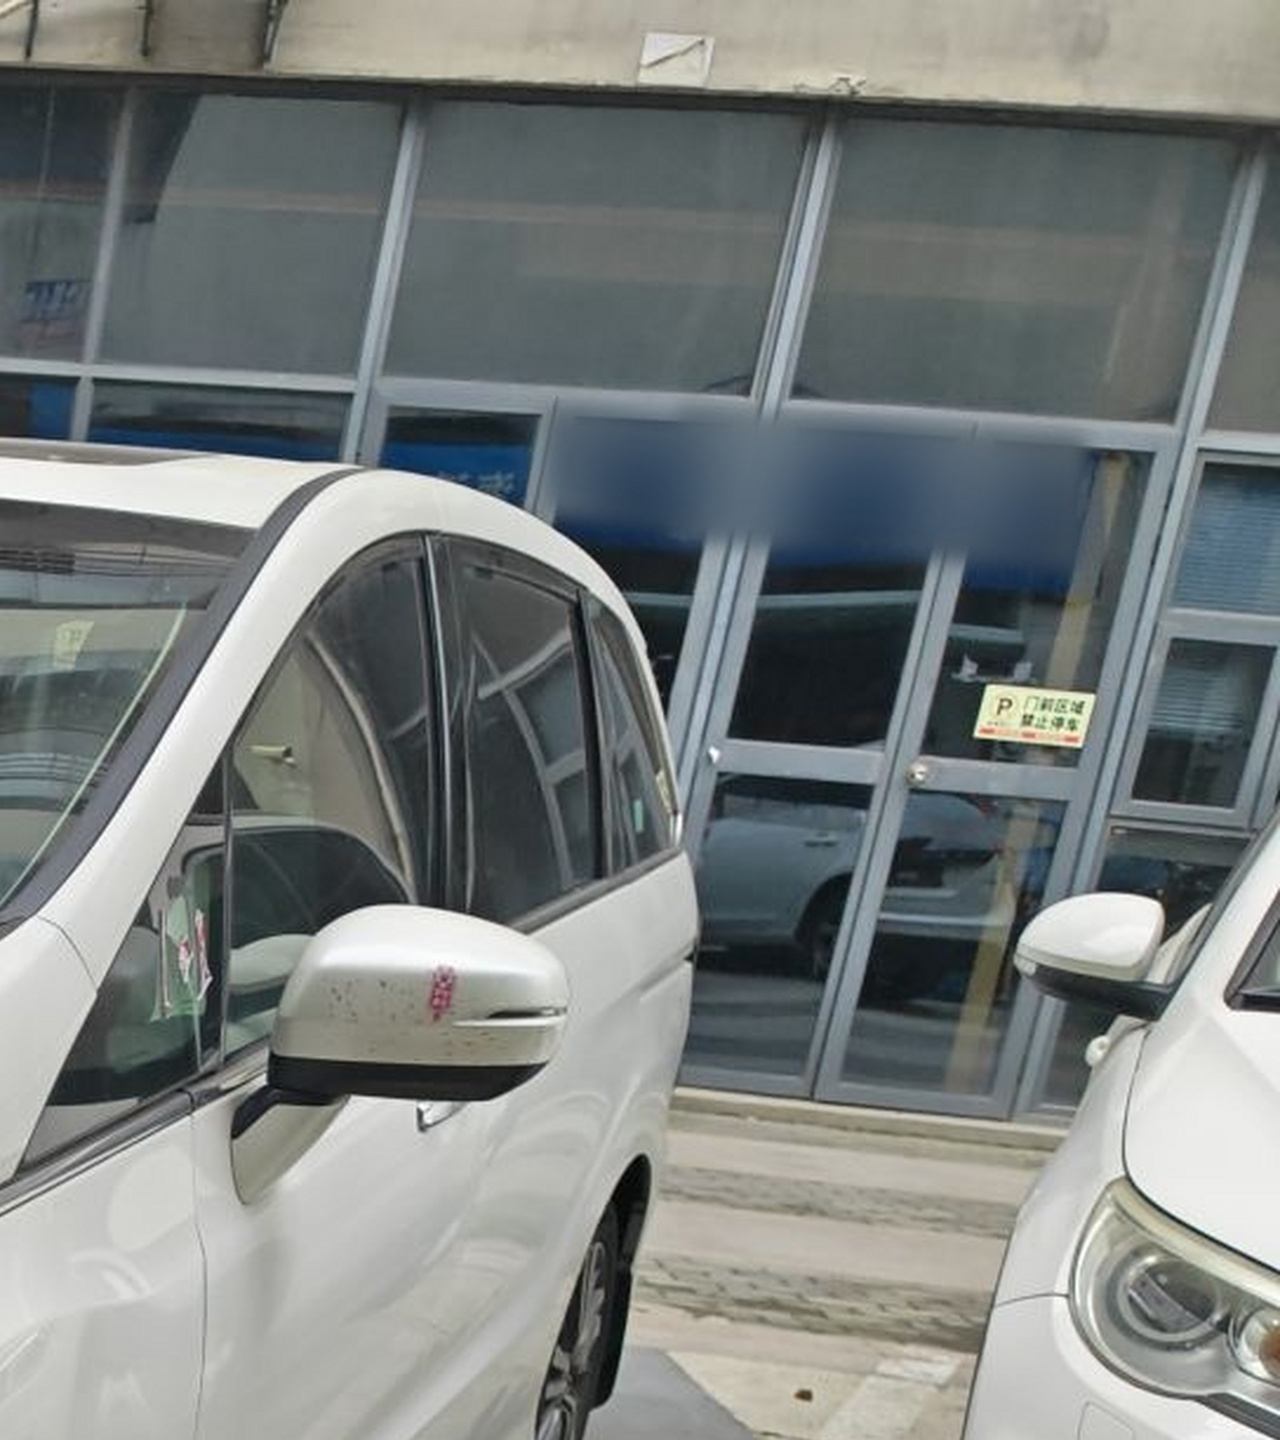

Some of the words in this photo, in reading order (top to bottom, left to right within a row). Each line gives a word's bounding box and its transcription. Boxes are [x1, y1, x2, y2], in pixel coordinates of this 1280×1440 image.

[997, 698, 1012, 716] P
[1025, 696, 1085, 715] 门前区域
[1021, 713, 1079, 731] 禁止停车
